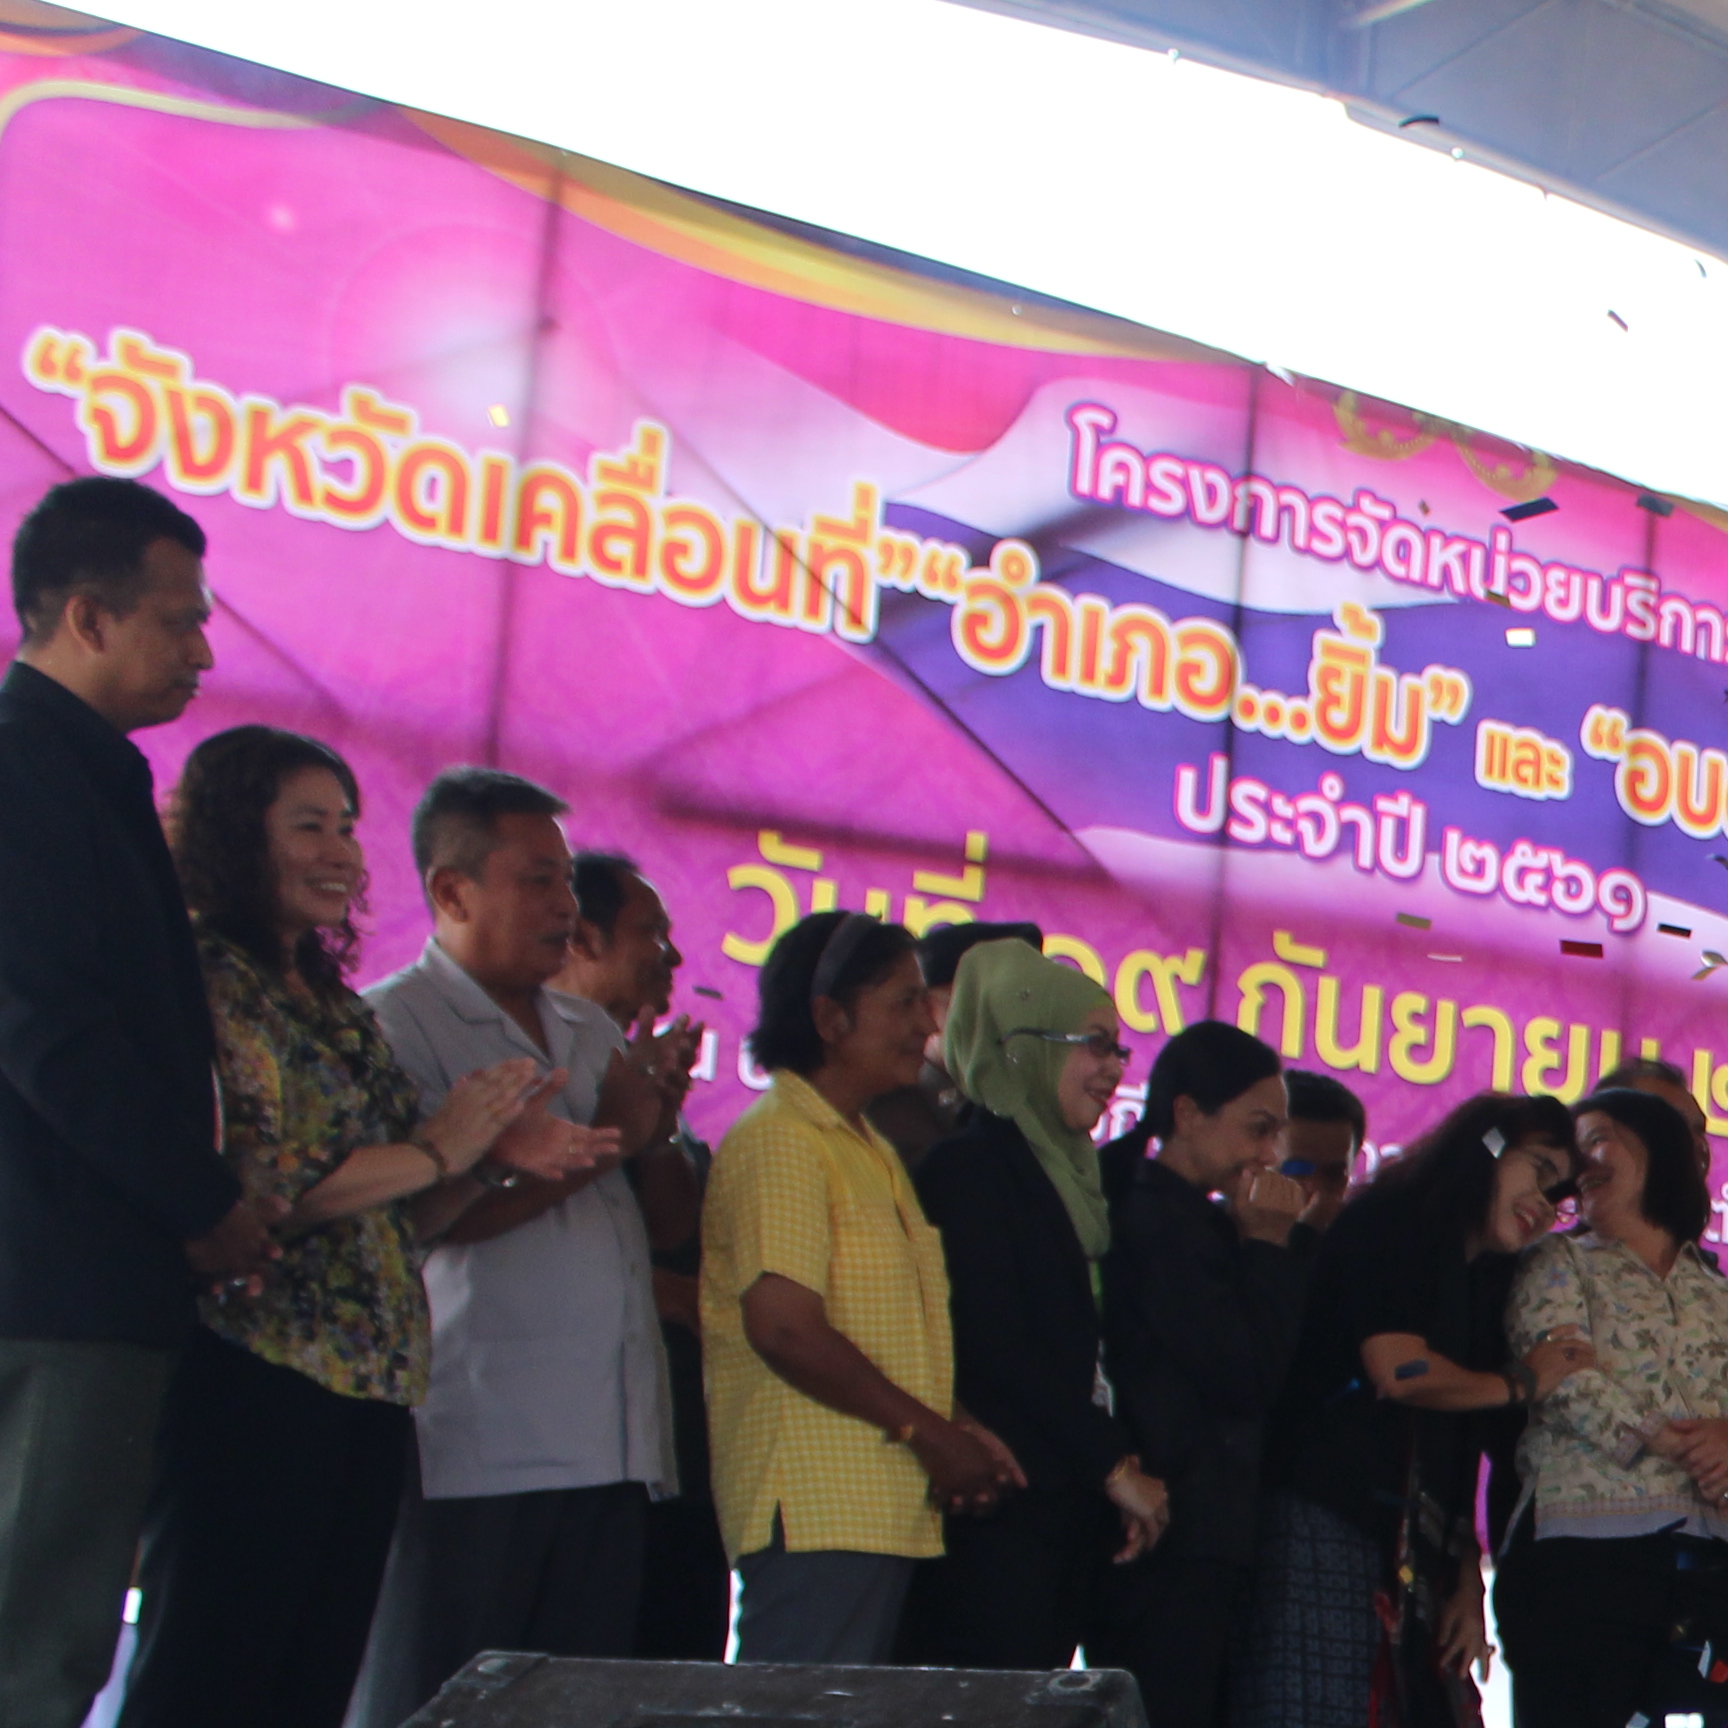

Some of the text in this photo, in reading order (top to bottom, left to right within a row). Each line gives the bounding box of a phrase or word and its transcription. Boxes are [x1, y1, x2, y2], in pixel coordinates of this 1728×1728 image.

[1475, 719, 1573, 800] และ
[1174, 752, 1649, 936] ประจำปี ๒๕๖๑
